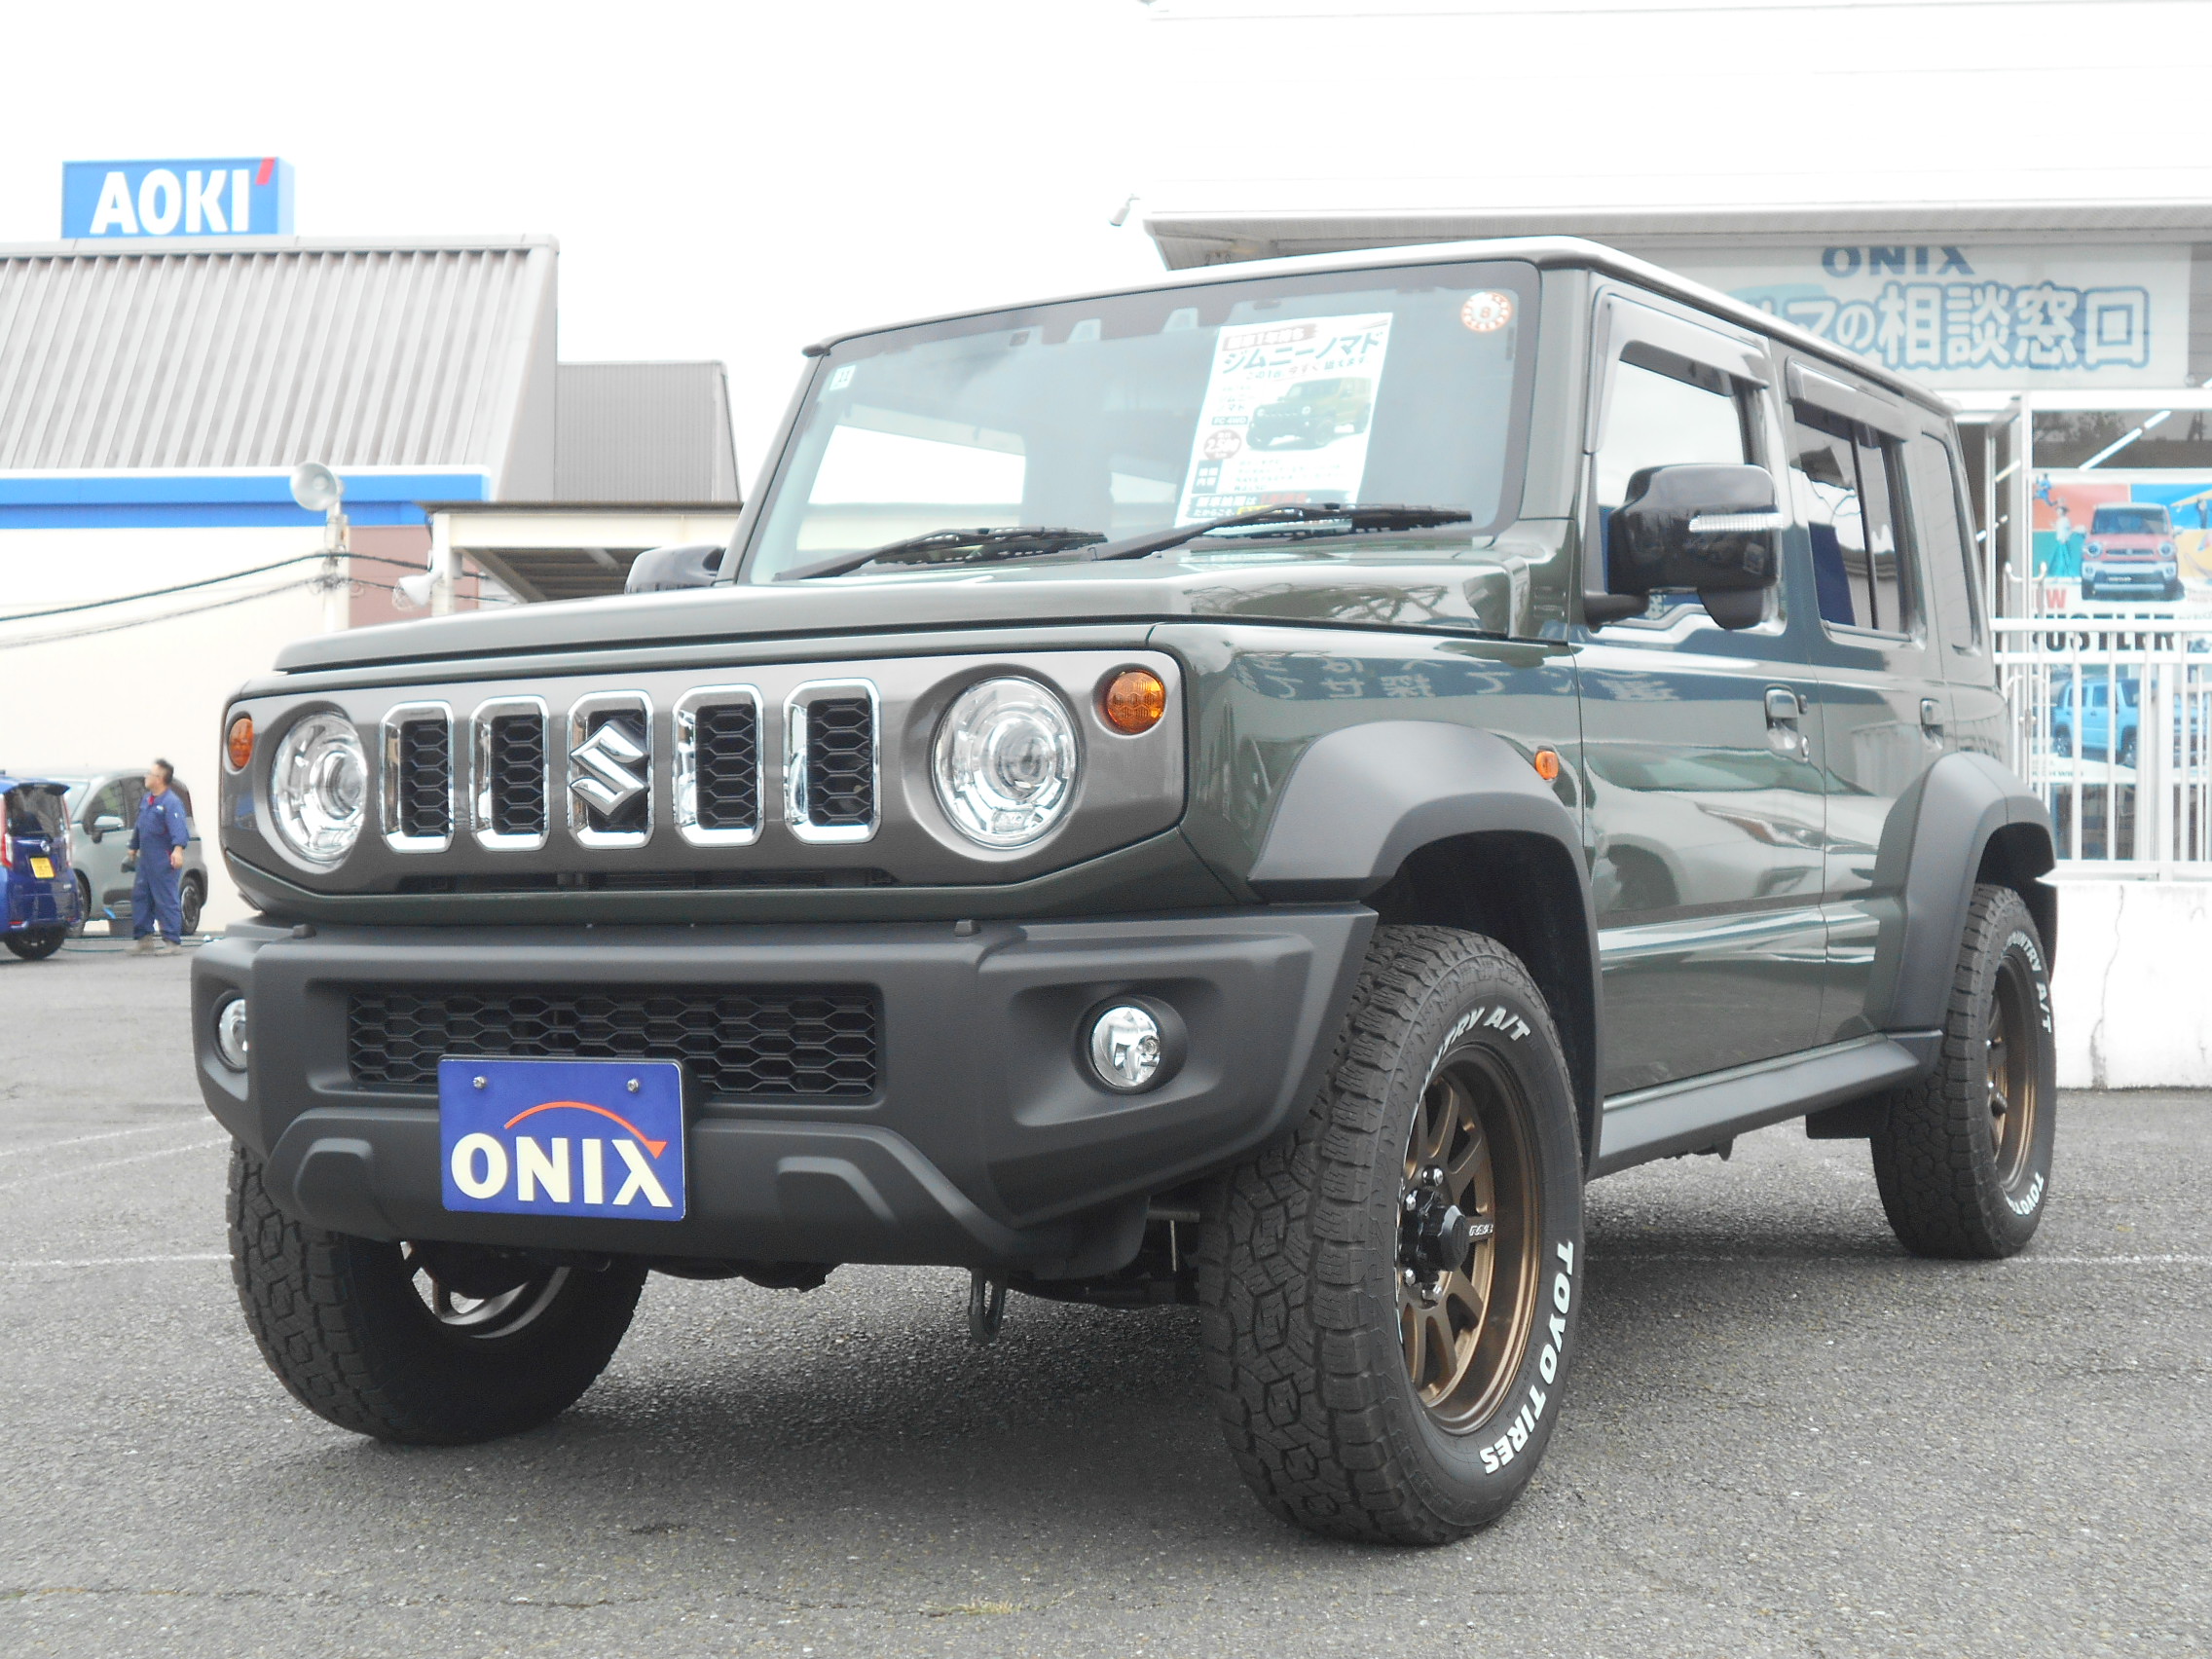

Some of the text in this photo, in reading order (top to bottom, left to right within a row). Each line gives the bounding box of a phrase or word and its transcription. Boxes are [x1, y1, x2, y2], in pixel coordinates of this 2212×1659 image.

[90, 167, 250, 236] AOKI
[1821, 245, 1974, 277] ONIX
[1223, 331, 1383, 375] ジムニーノマド
[2032, 613, 2175, 650] USTLER
[1483, 1006, 1530, 1041] A/T
[2036, 982, 2052, 1033] A/T
[451, 1132, 673, 1208] ONIX
[1479, 1240, 1574, 1475] TOYO TIRES
